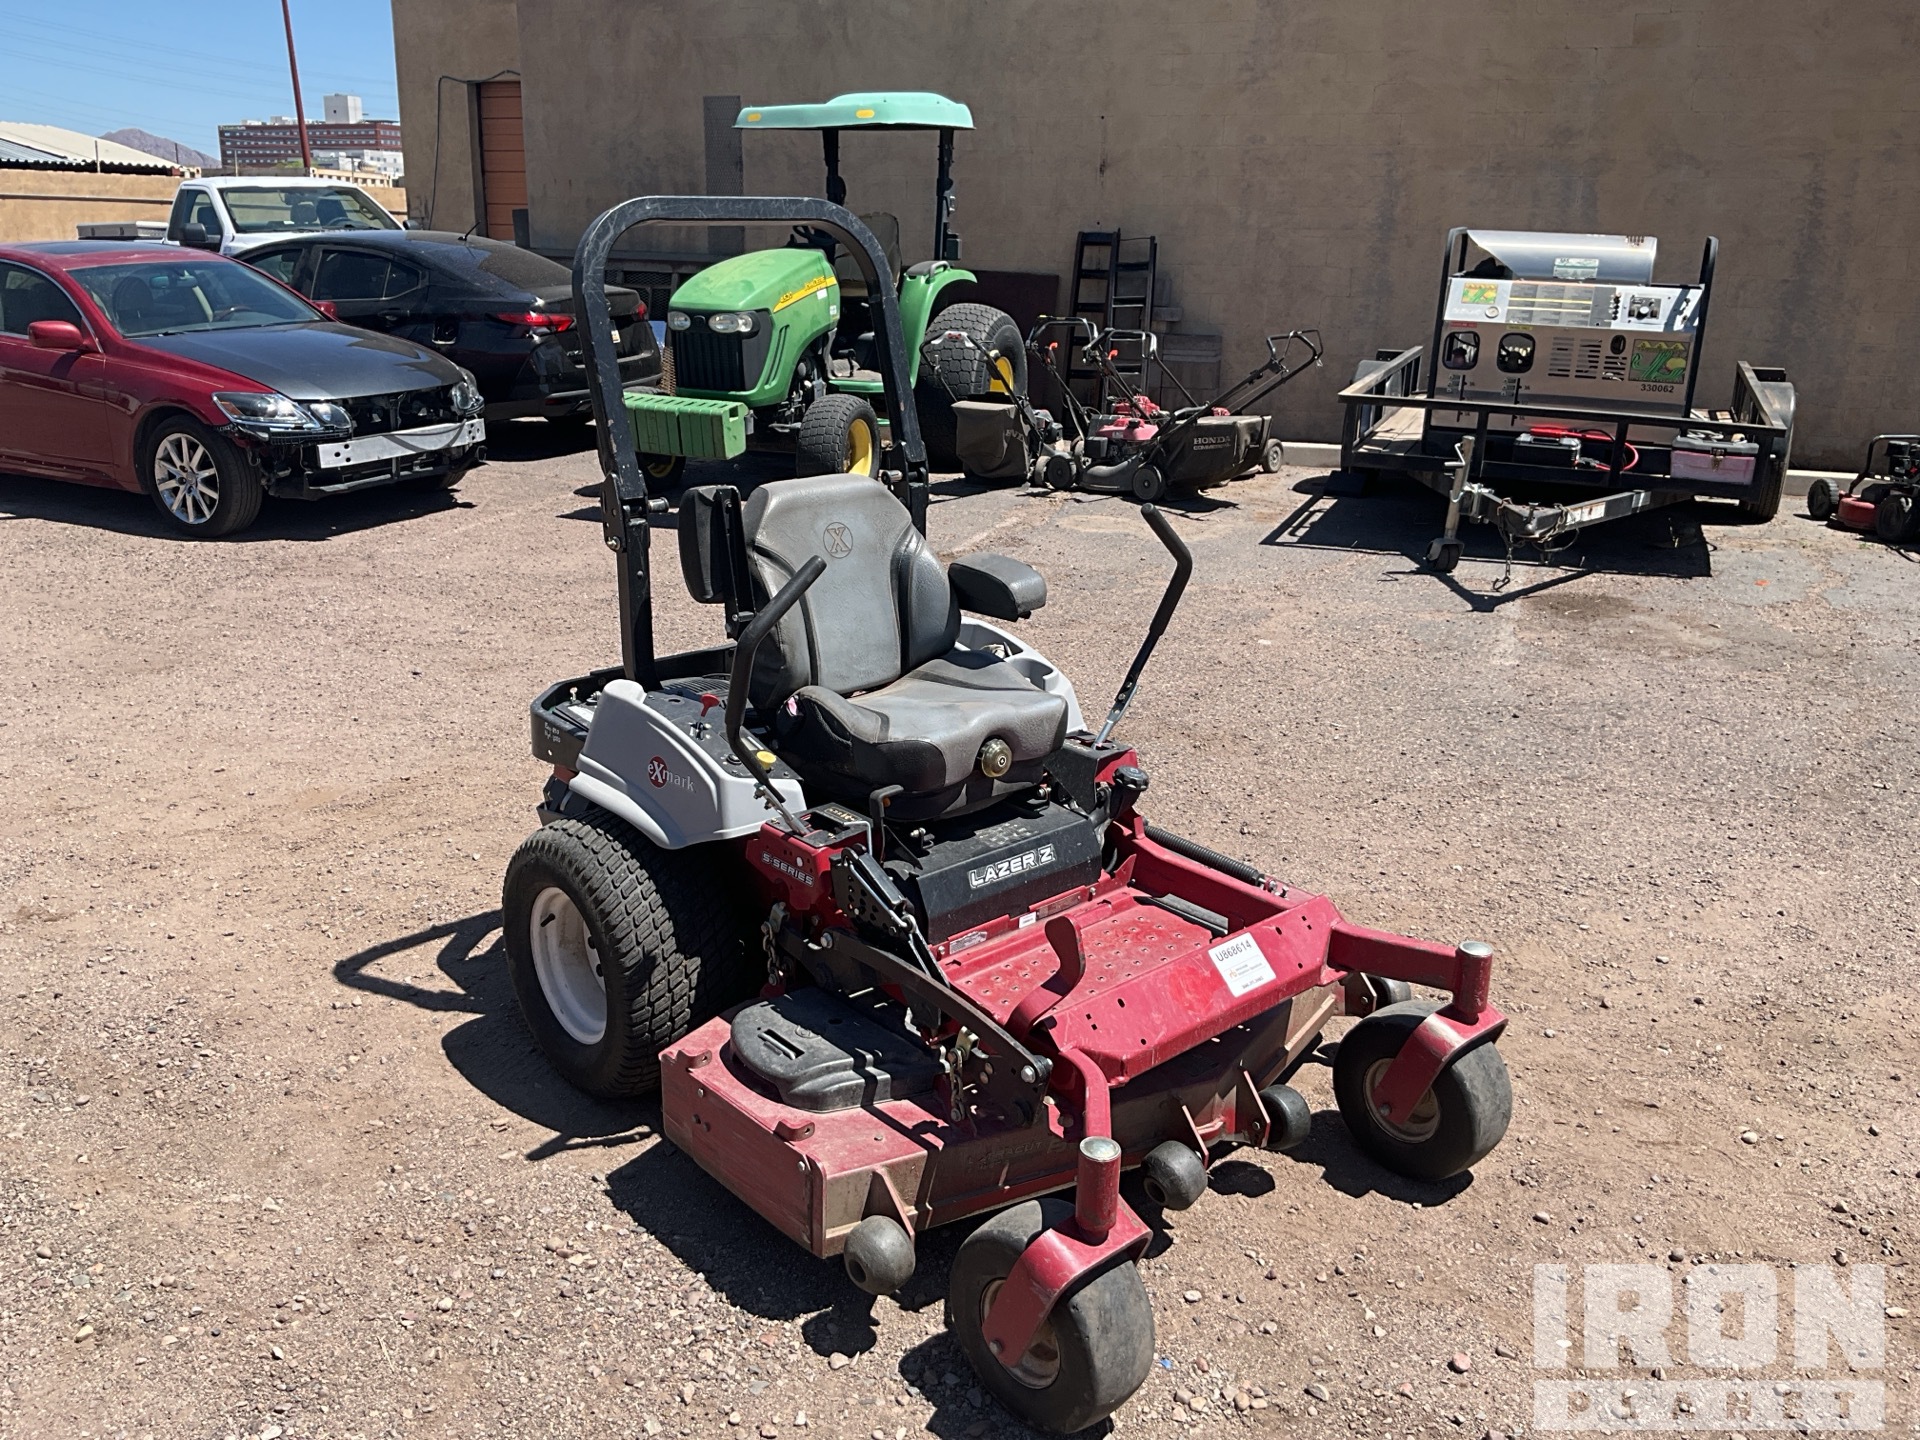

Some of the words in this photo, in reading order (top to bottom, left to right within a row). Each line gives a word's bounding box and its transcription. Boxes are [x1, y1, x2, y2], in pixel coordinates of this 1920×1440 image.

[1640, 383, 1675, 394] 330062
[1193, 435, 1231, 445] HONDA
[647, 760, 695, 792] eXmark
[762, 852, 814, 886] S-SERIES
[969, 852, 1037, 887] LAZER
[1039, 845, 1055, 865] Z
[1214, 939, 1252, 962] U868614
